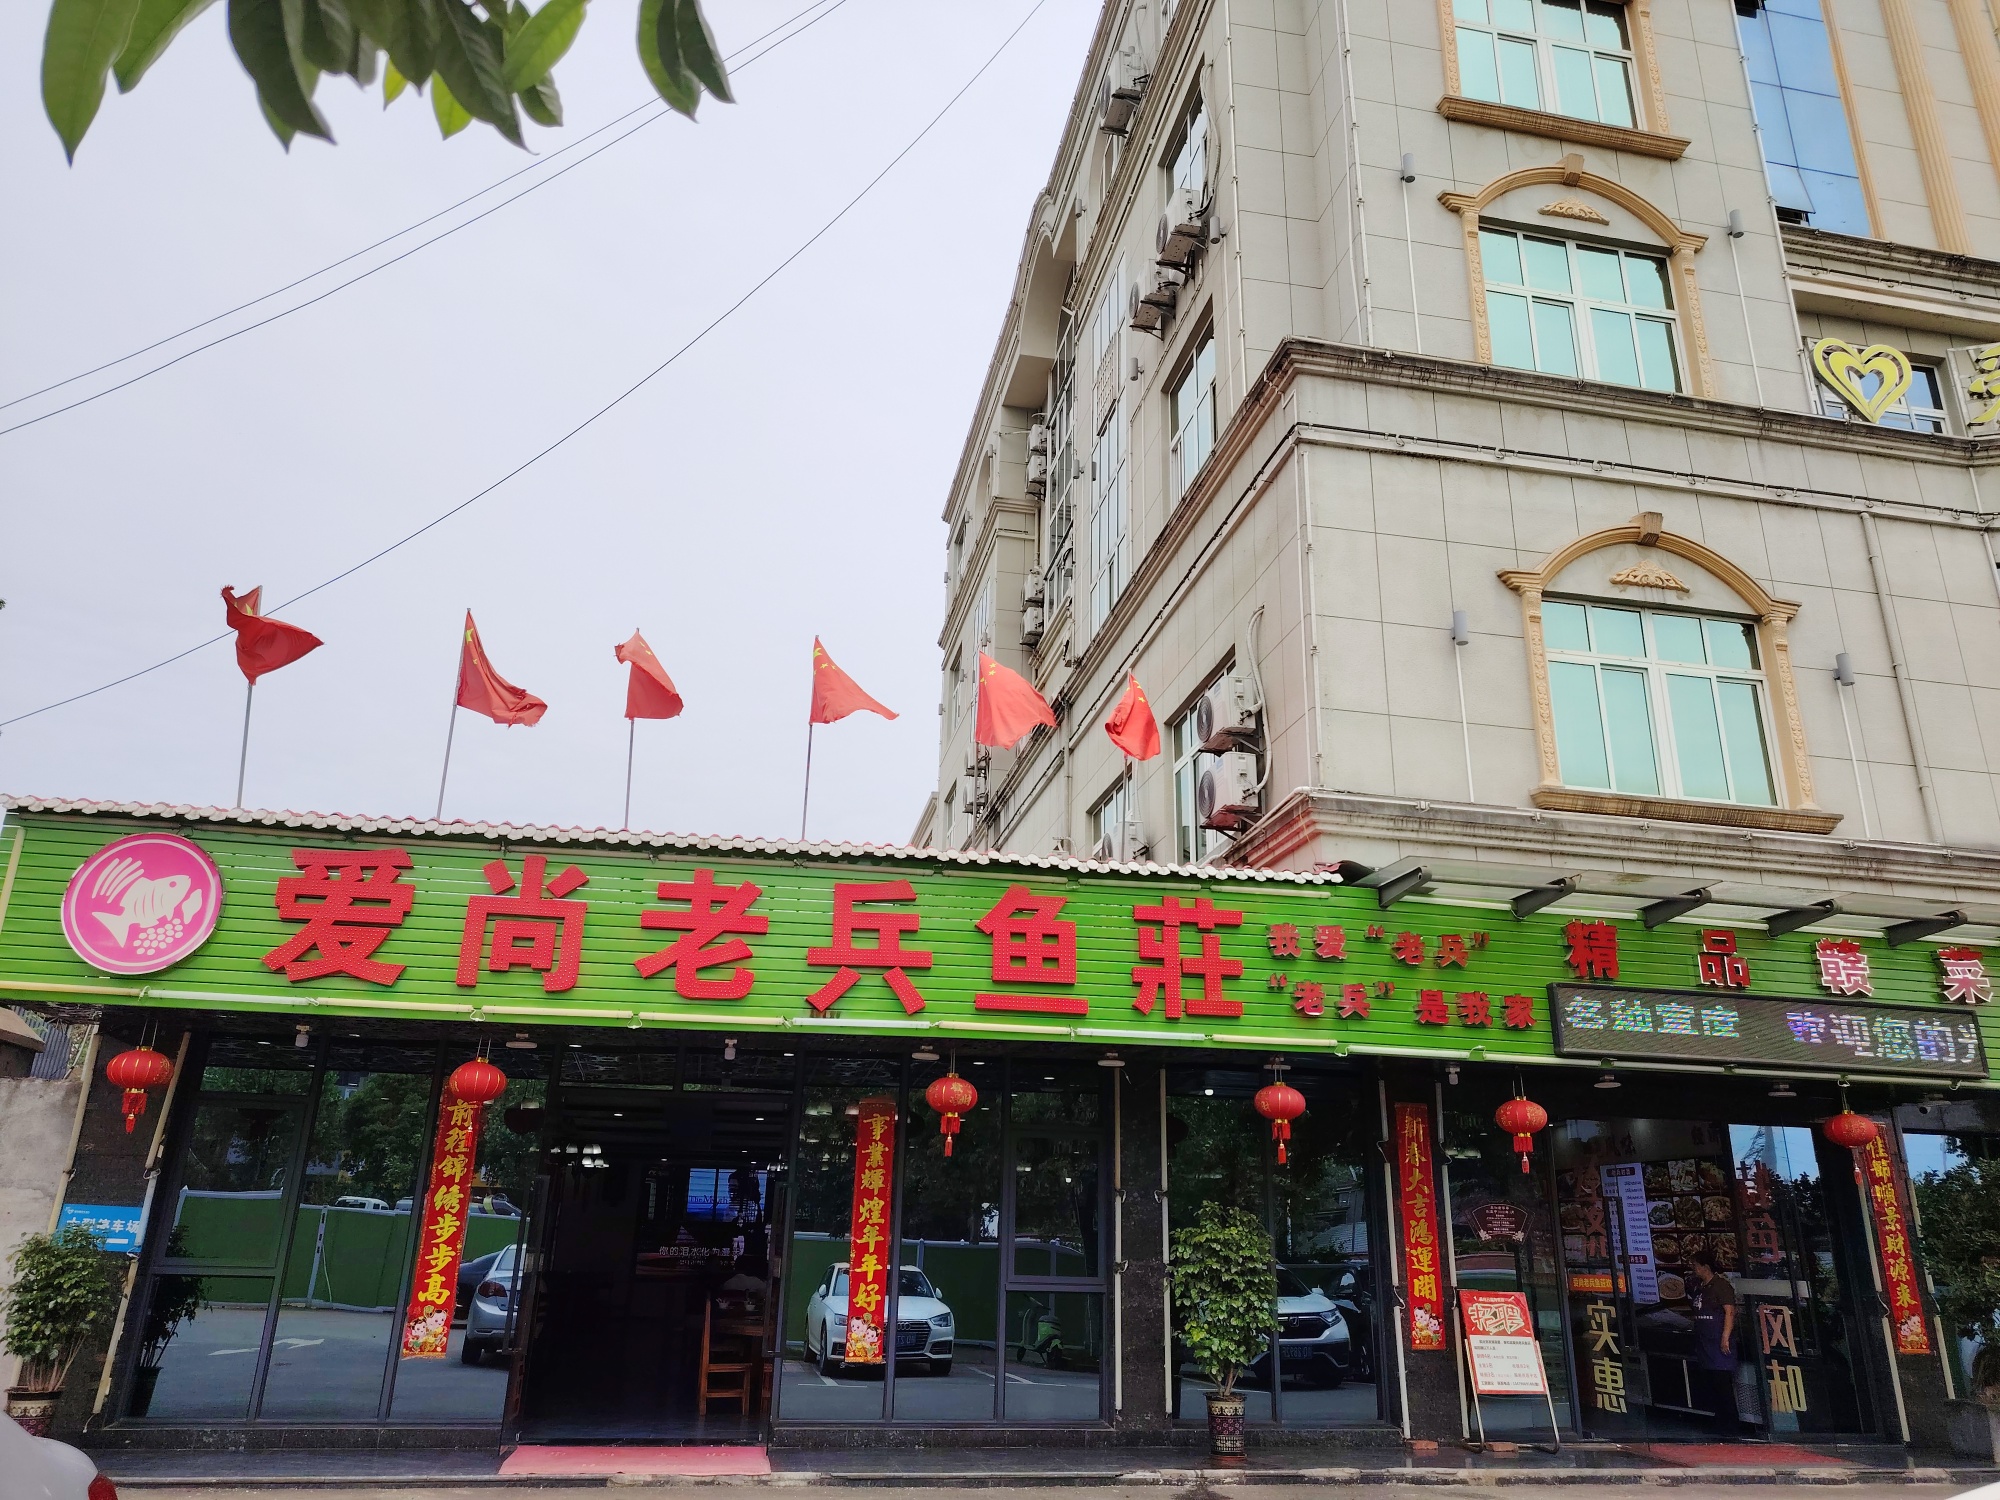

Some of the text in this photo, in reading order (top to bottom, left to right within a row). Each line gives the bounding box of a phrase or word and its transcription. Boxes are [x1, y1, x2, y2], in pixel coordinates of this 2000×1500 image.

[1562, 918, 1993, 1005] 精品赣菜
[1587, 1299, 1628, 1414] 实惠
